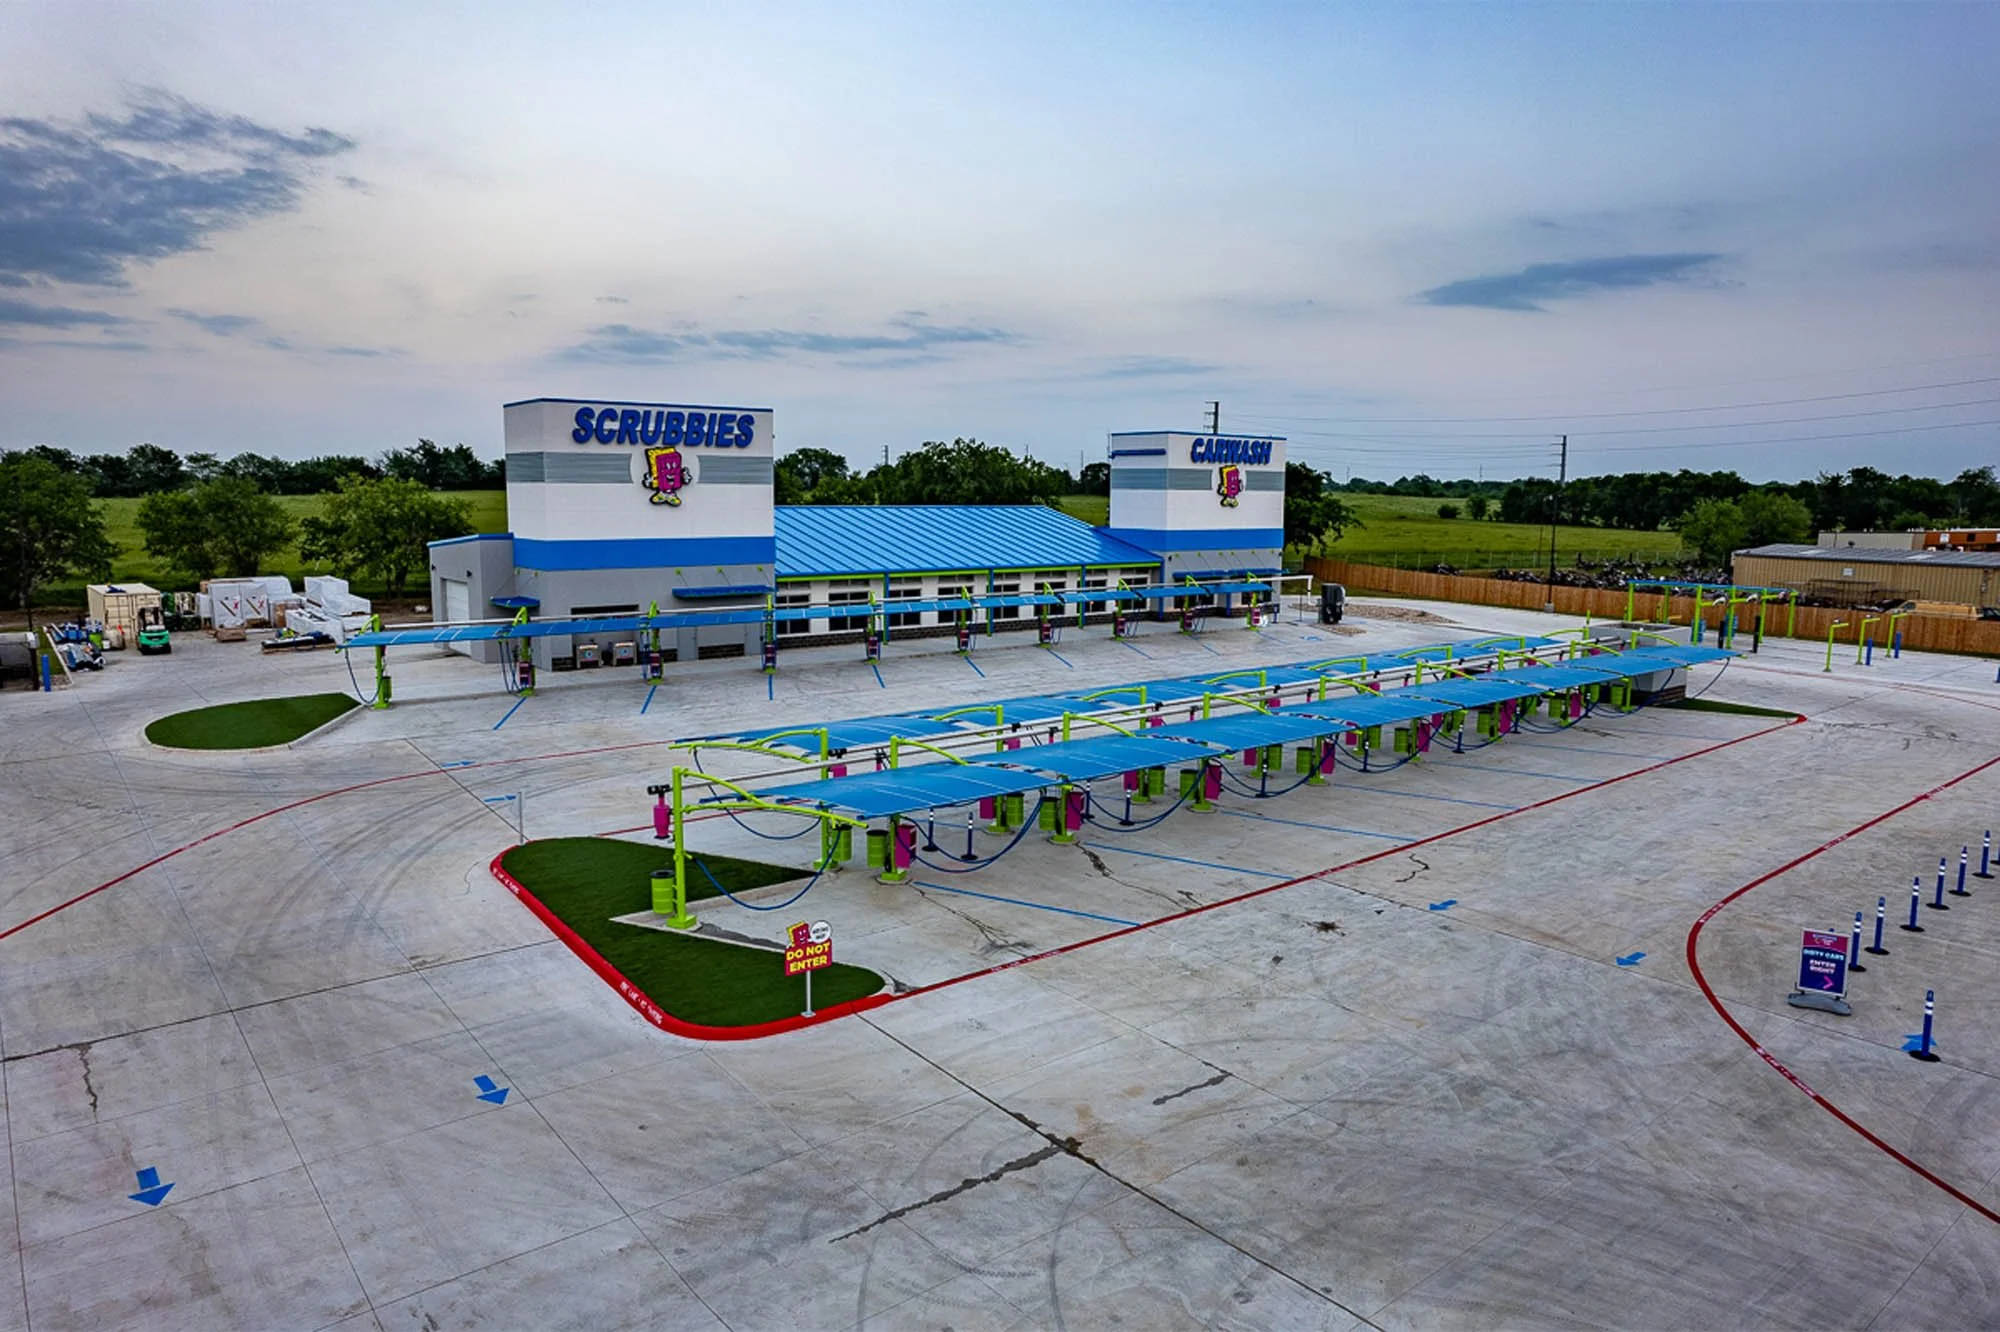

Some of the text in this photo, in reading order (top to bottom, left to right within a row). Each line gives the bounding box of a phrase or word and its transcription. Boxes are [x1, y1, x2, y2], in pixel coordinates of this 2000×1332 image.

[572, 406, 755, 448] SCRUBBIES
[1190, 437, 1272, 465] CARWASH
[786, 942, 830, 961] DO NOT
[790, 955, 827, 972] ENTER
